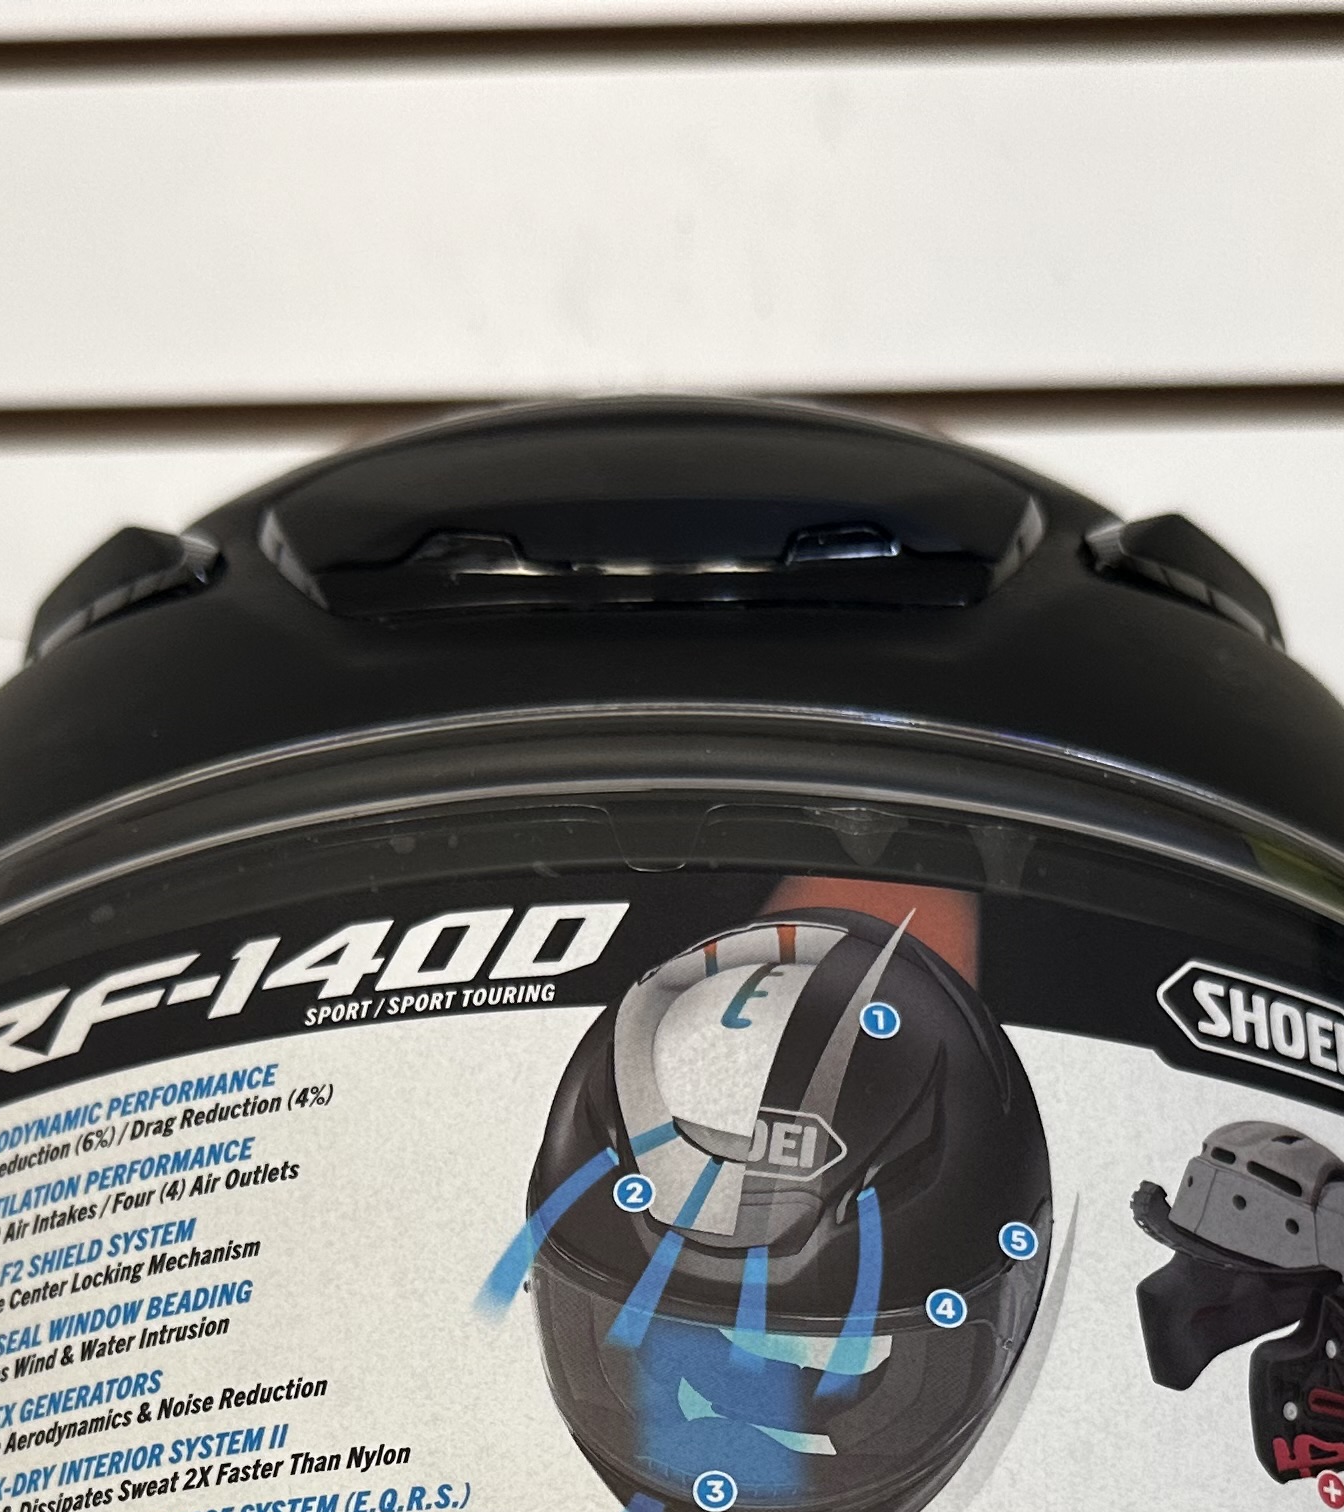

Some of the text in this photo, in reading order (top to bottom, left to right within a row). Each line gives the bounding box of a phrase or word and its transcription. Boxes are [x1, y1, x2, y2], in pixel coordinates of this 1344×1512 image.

[305, 1001, 371, 1027] SPORT
[387, 991, 455, 1015] SPORT
[460, 983, 556, 1008] TOURING
[75, 1128, 116, 1157] (6%)
[130, 1112, 176, 1140] Drag
[180, 1093, 281, 1129] Reduction
[289, 1083, 334, 1111] (4%)
[106, 1064, 279, 1120] PERFORMANCE
[85, 1137, 255, 1195] PERFORMANCE
[4, 1215, 28, 1243] Air
[32, 1202, 97, 1235] Intakes
[112, 1190, 151, 1214] Four
[159, 1180, 186, 1205] (4)
[189, 1173, 220, 1197] Air
[225, 1161, 299, 1189] Outlets
[9, 1282, 67, 1310] Center
[71, 1262, 142, 1293] Locking
[147, 1239, 260, 1276] Mechanism
[28, 1238, 101, 1279] SHIELD
[106, 1218, 197, 1258] SYSTEM
[48, 1300, 142, 1341] WINDOW
[146, 1279, 253, 1320] BEADING
[14, 1349, 56, 1378] Wind
[60, 1348, 74, 1367] &
[79, 1335, 136, 1360] Water
[139, 1316, 229, 1347] Intrusion
[4, 1405, 131, 1454] Aerodynamics
[137, 1404, 151, 1424] &
[157, 1395, 213, 1420] Noise
[218, 1376, 328, 1409] Reduction
[20, 1369, 163, 1420] GENERATORS
[57, 1443, 164, 1485] INTERIOR
[168, 1426, 266, 1465] SYSTEM
[269, 1424, 289, 1449] II
[118, 1472, 179, 1501] Sweat
[182, 1467, 212, 1491] 2X
[216, 1460, 284, 1485] Faster
[290, 1452, 341, 1476] Than
[346, 1443, 411, 1473] Nylon
